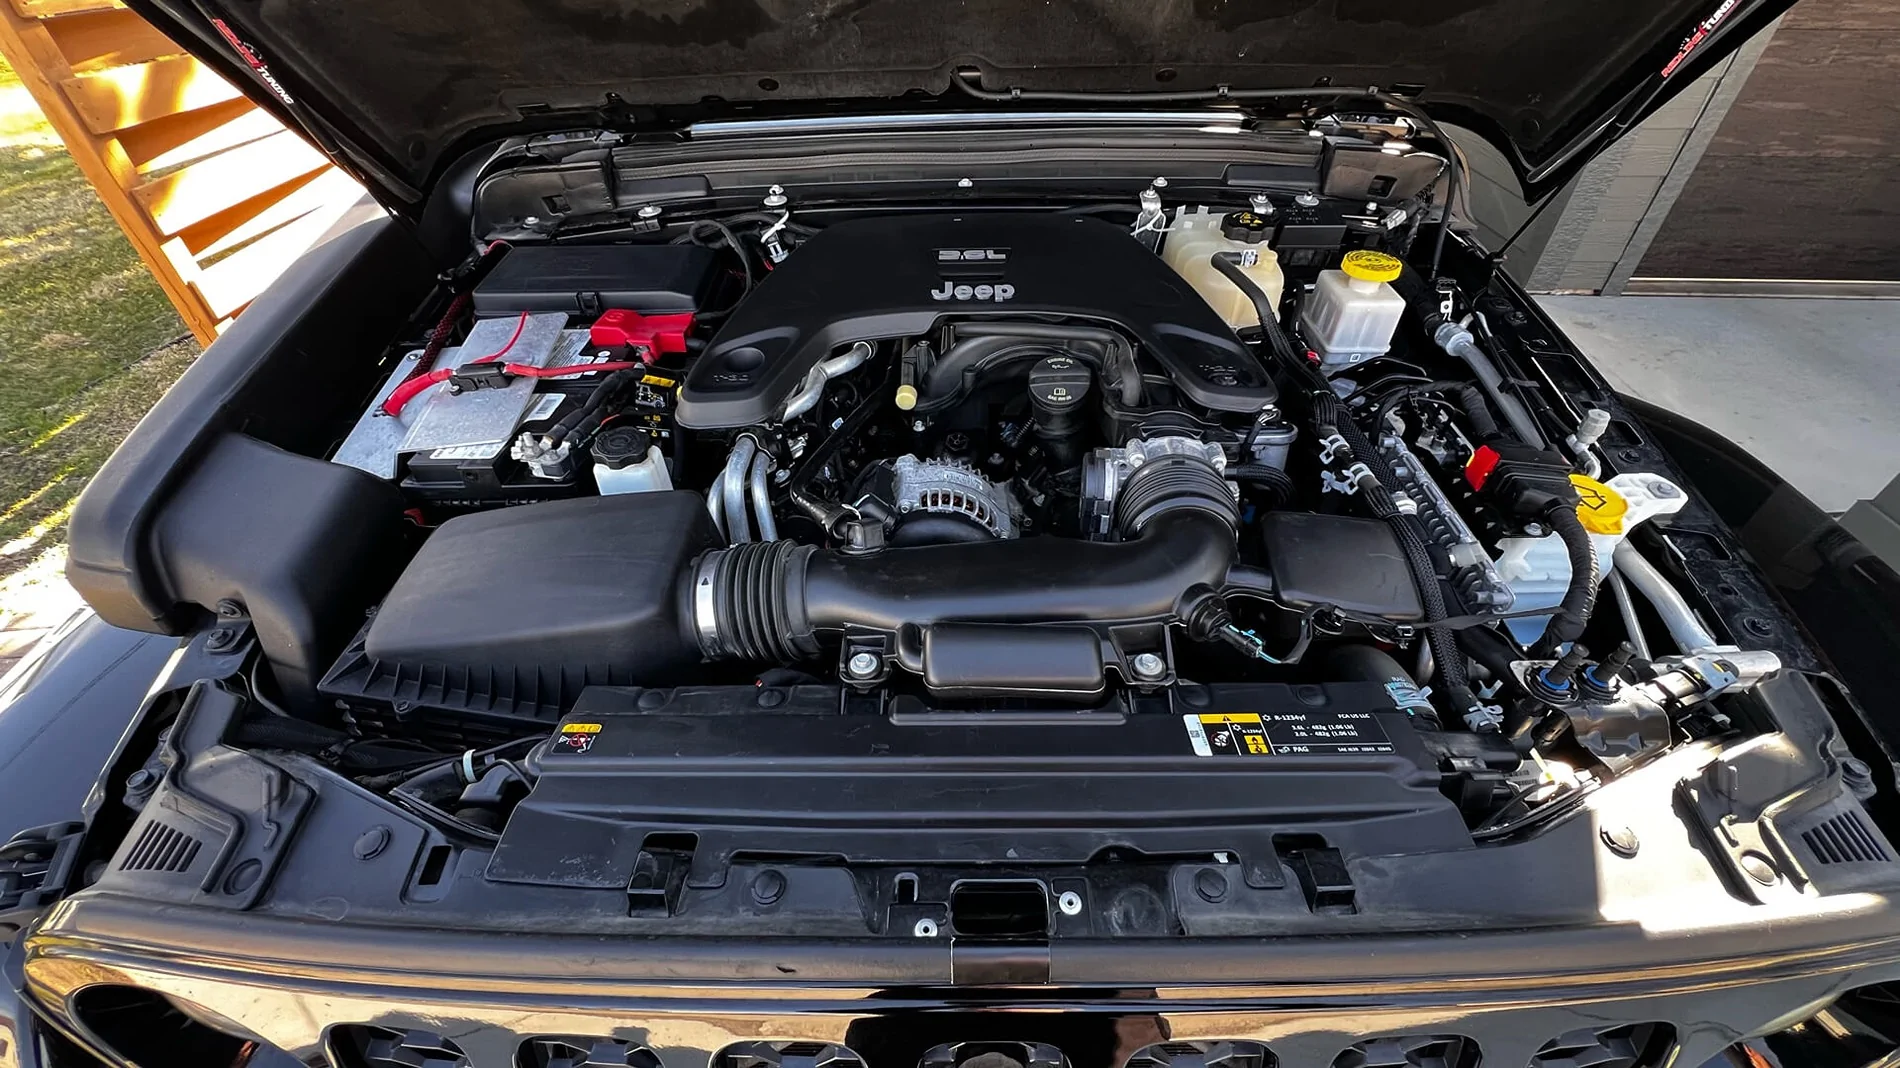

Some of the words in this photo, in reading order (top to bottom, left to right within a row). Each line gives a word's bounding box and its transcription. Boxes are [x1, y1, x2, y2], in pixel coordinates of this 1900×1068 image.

[257, 66, 294, 104] TUNING
[931, 281, 1015, 302] Jeep
[1274, 713, 1306, 721] R-1234yf
